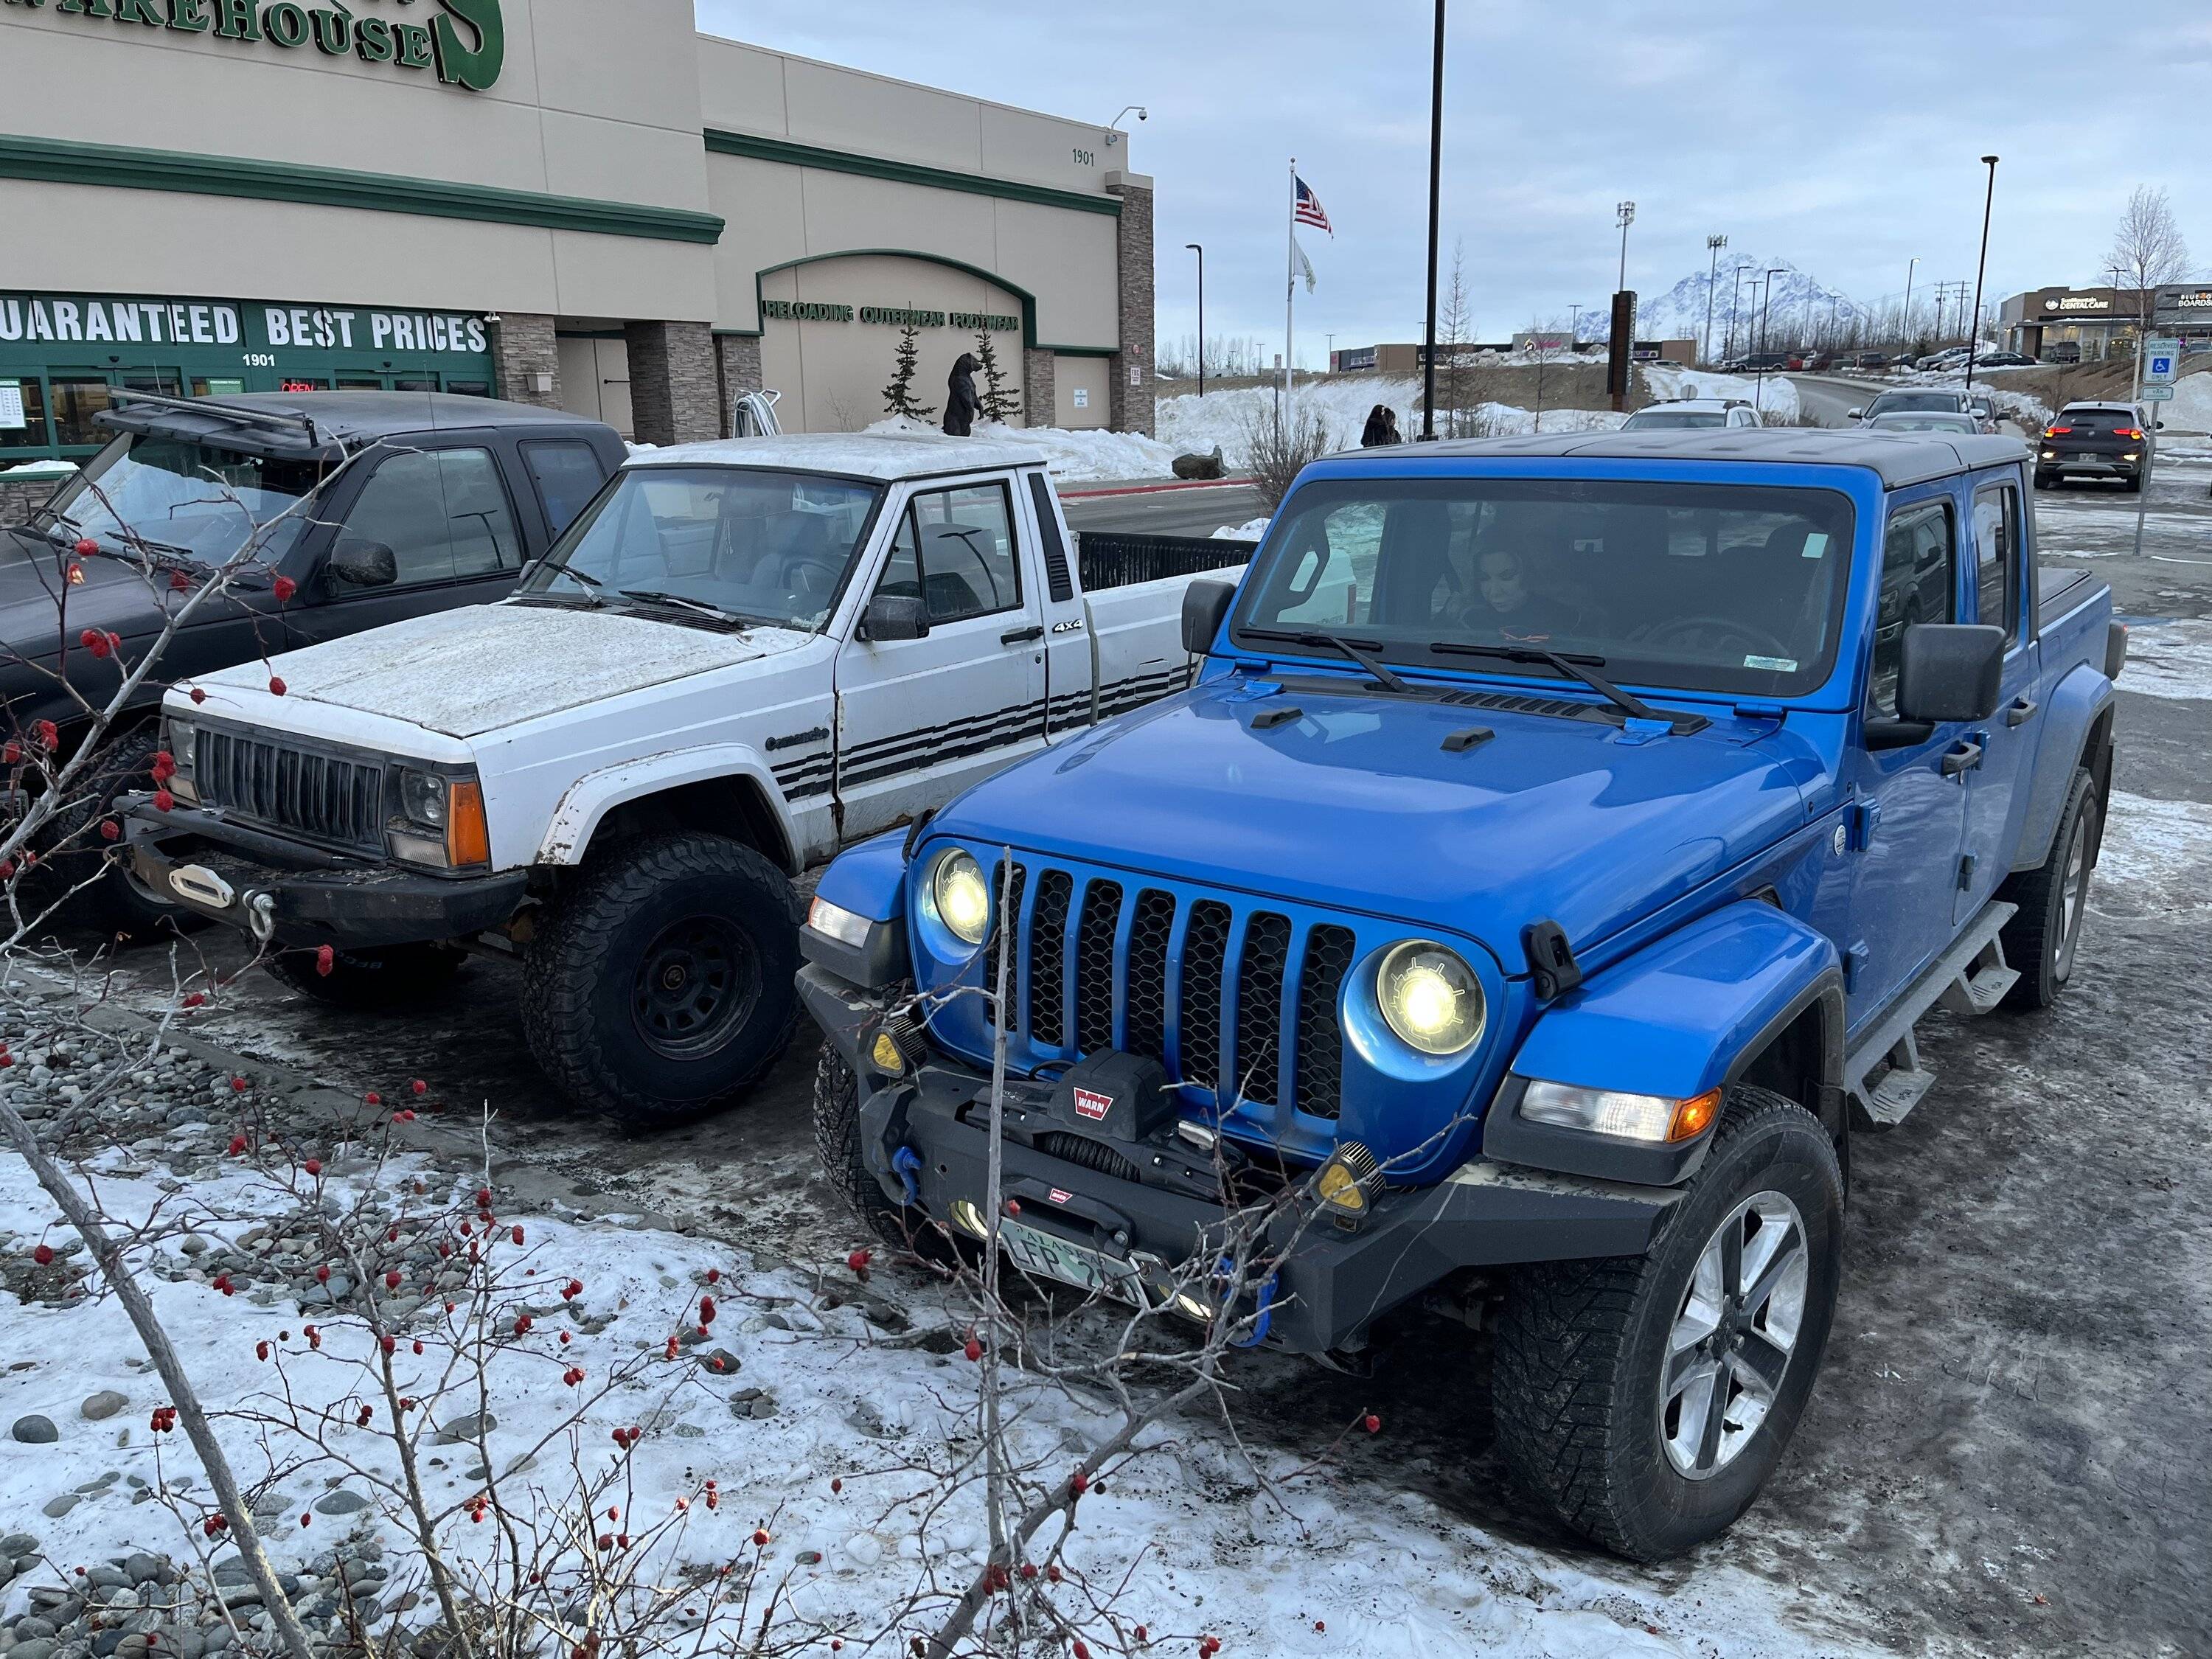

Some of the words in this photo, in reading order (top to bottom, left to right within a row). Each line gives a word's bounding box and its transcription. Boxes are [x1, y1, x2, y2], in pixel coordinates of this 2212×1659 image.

[4, 0, 434, 68] REHOUSE
[1072, 148, 1094, 167] 1901
[2059, 302, 2089, 310] DENTAL
[2088, 301, 2109, 309] CARE
[2178, 299, 2212, 307] BOARDS
[763, 300, 855, 322] RELOADING
[860, 306, 946, 327] OUTERWEAR
[950, 312, 1020, 330] FOOTWEAR
[265, 308, 355, 348] BEST
[371, 313, 487, 352] PRICES
[243, 353, 276, 366] 1901
[282, 383, 314, 392] OPEN
[1078, 1096, 1105, 1113] WARN
[1051, 1191, 1068, 1200] WARN
[1002, 1231, 1060, 1275] LFP
[1027, 1233, 1101, 1267] ALASKA
